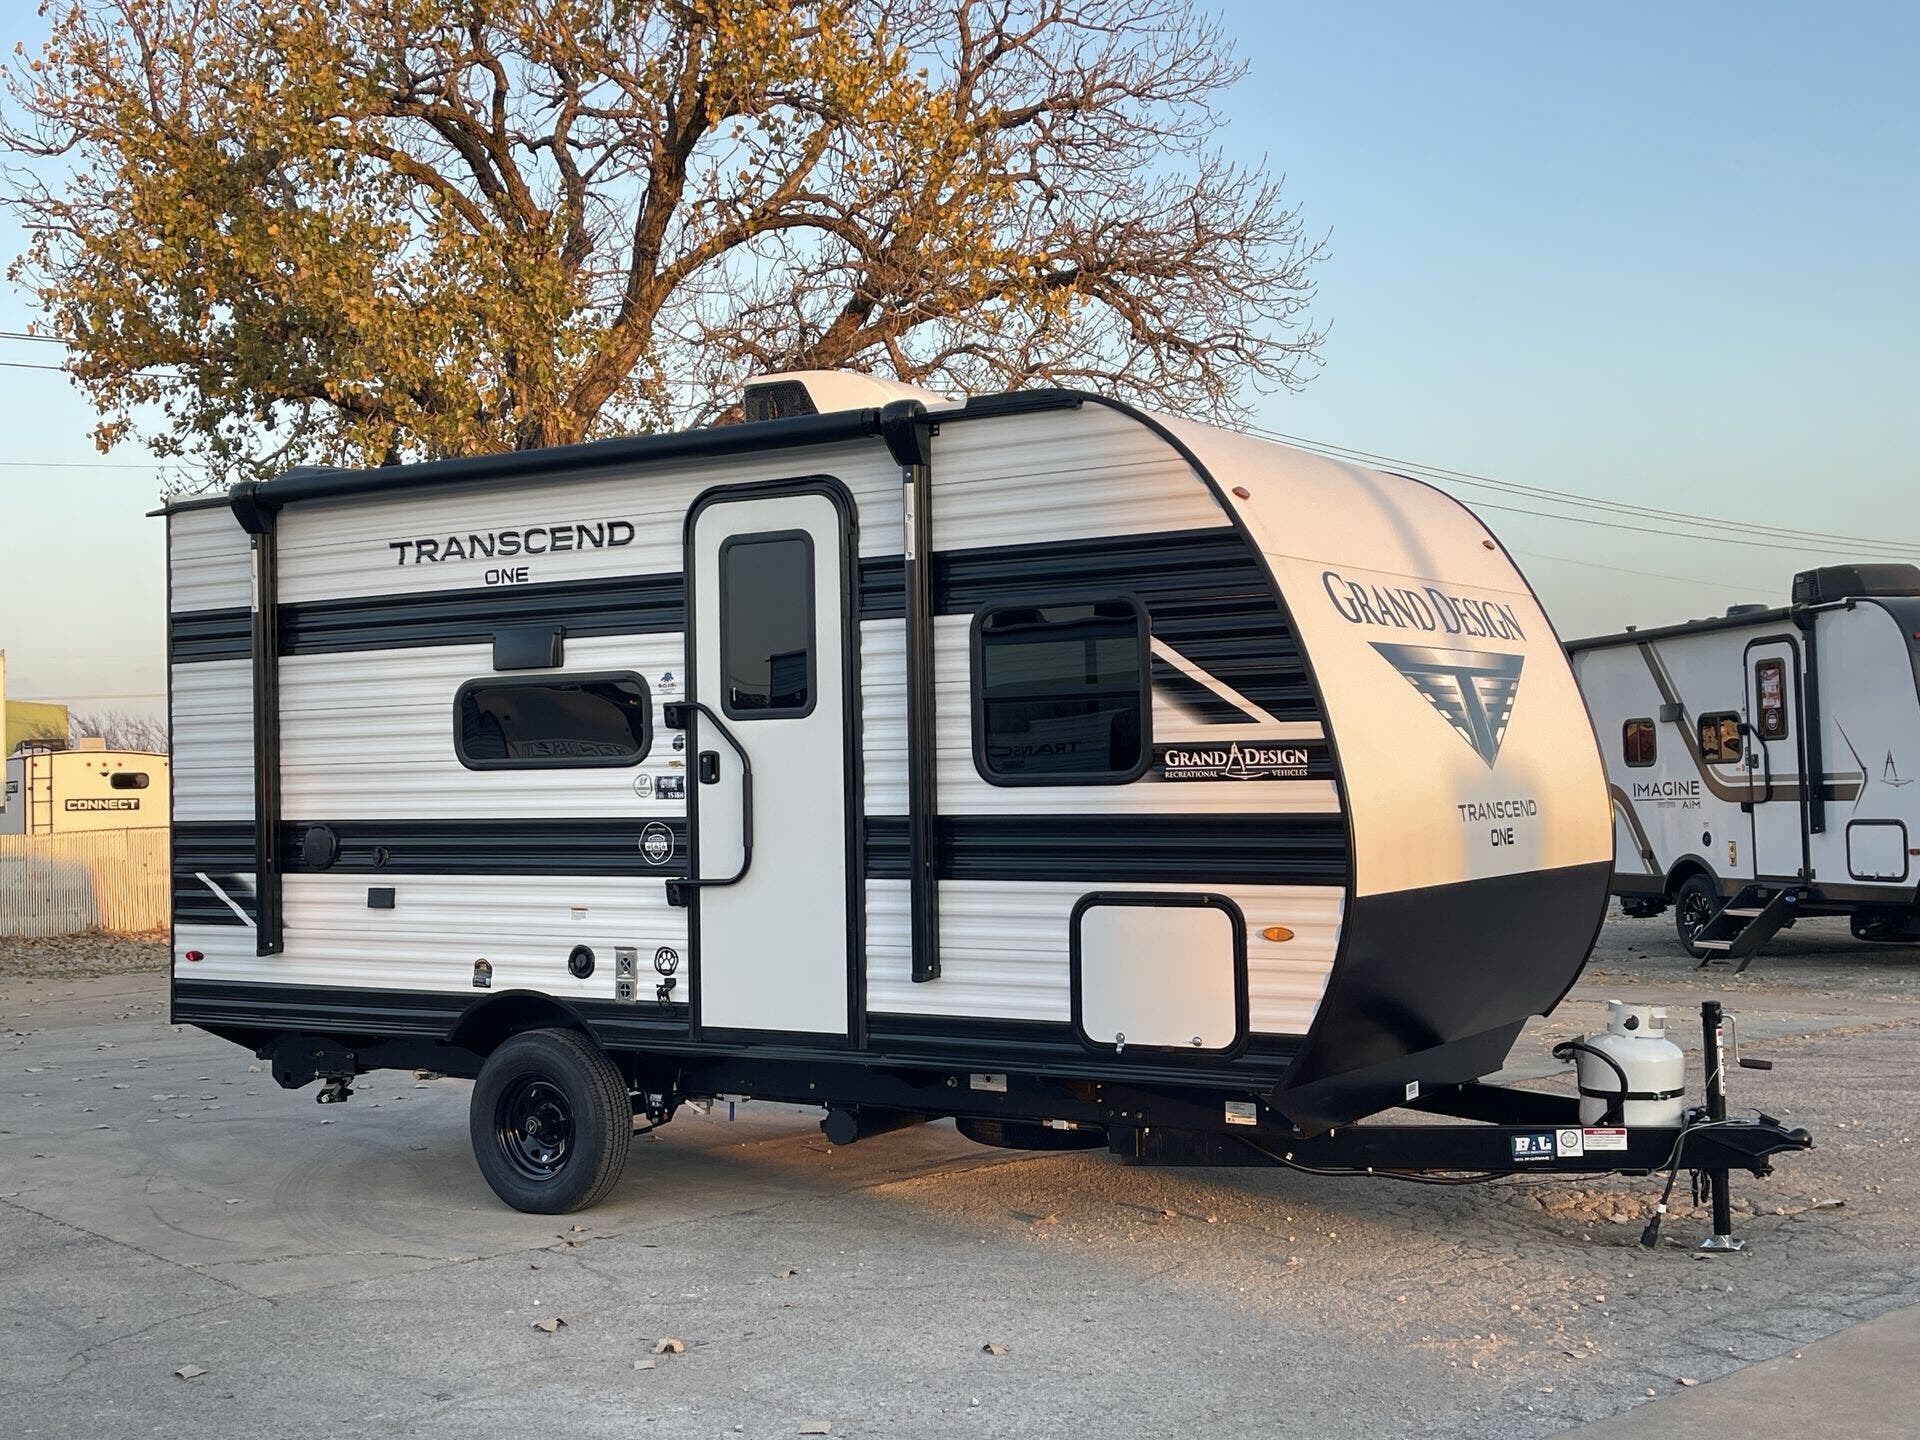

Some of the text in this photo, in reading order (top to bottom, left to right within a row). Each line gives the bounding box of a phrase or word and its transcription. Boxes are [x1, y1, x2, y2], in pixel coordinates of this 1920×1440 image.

[389, 521, 635, 566] TRANSCEND
[485, 567, 529, 585] ONE
[1322, 571, 1527, 642] GRAND DESIGN
[1164, 749, 1308, 767] GRAND DESIGN
[1165, 768, 1308, 778] RECREATIONAL VEHICLES
[1633, 780, 1700, 798] IMAGINE
[66, 799, 138, 810] CONNECT
[1457, 799, 1537, 822] TRANSCEND
[1682, 800, 1701, 809] AIM
[1490, 827, 1514, 847] ONE
